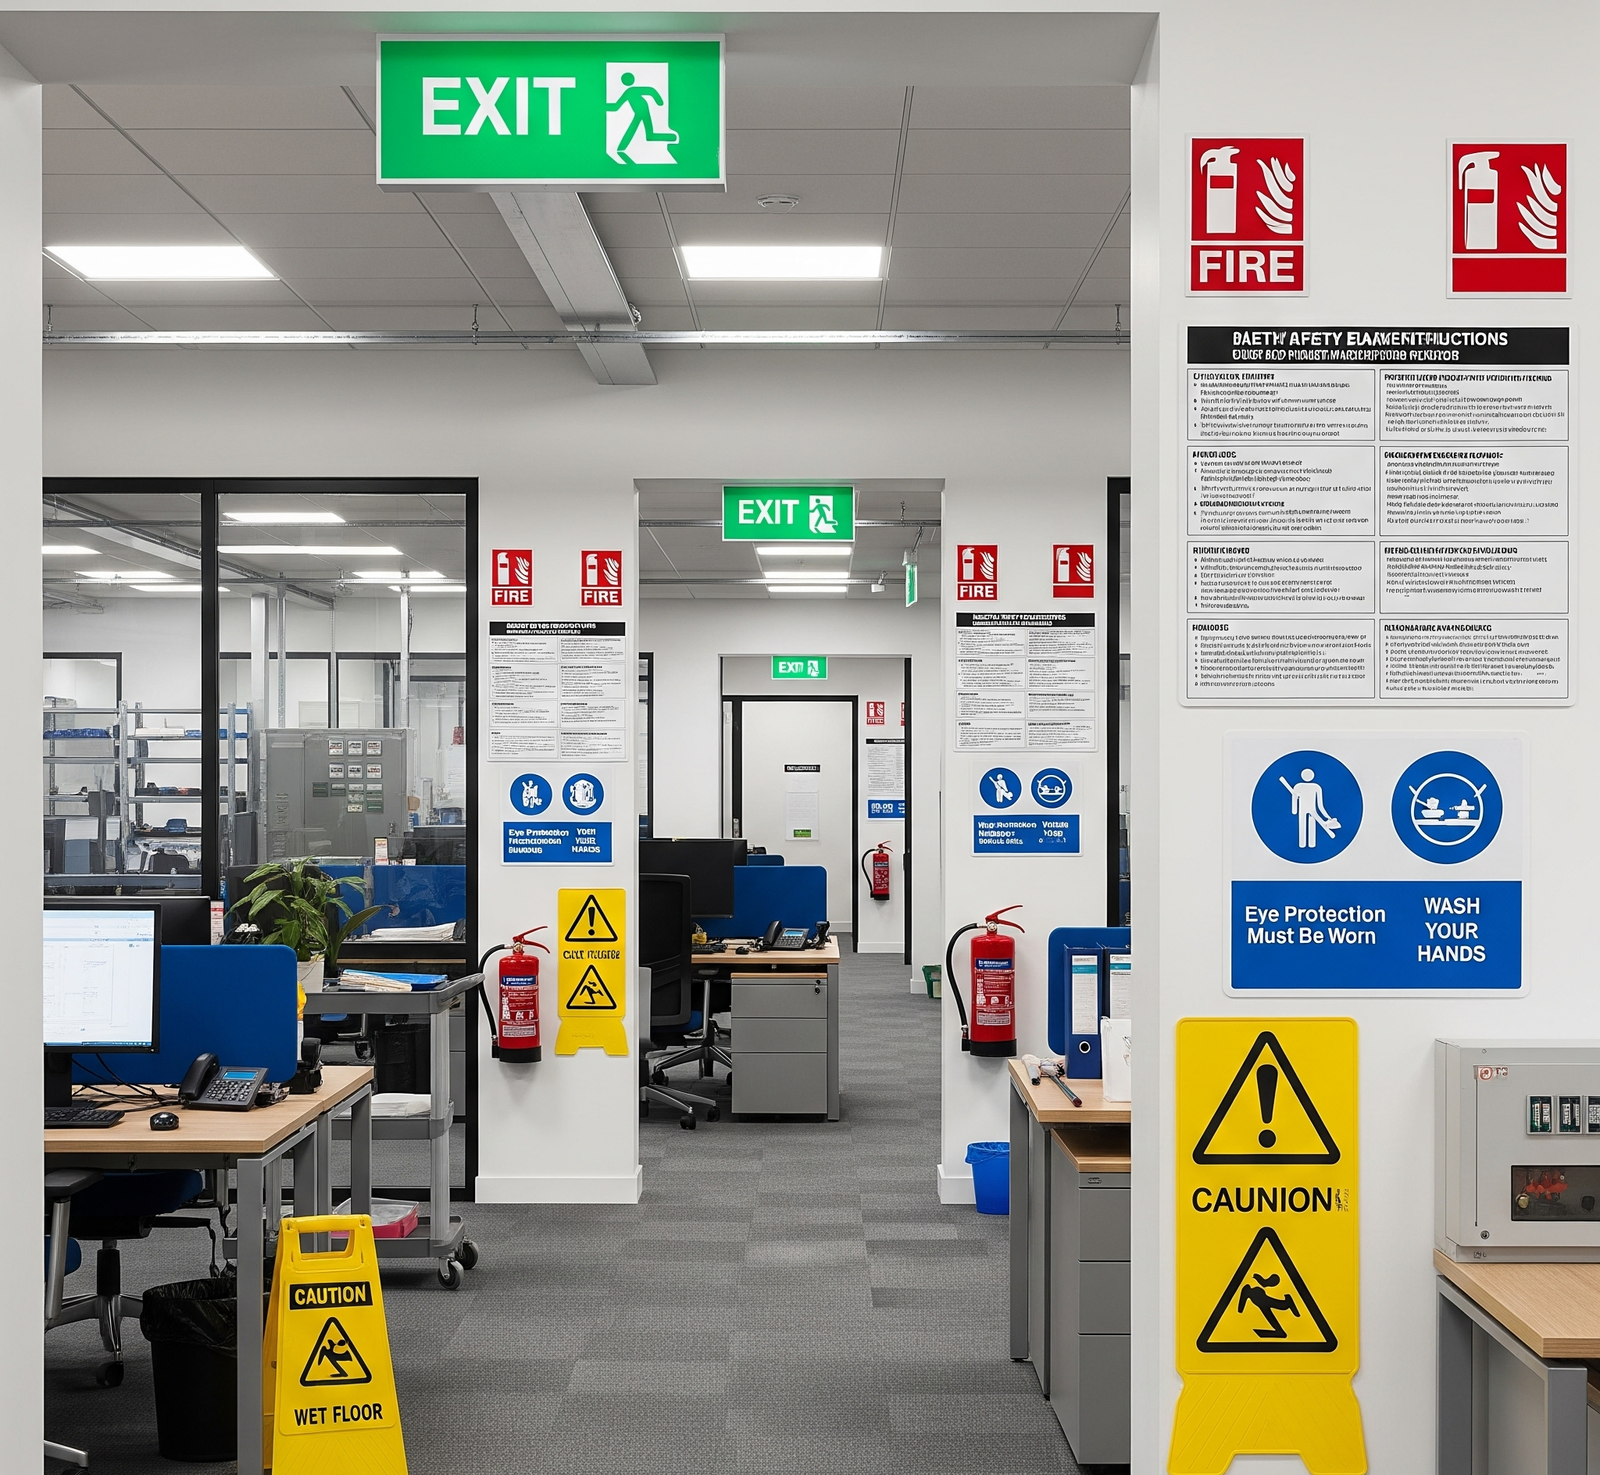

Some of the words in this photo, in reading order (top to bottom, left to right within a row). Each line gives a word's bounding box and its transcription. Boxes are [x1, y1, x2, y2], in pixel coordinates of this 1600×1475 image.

[422, 76, 576, 136] EXIT
[1198, 249, 1296, 284] FIRE
[738, 499, 800, 525] EXIT
[494, 589, 529, 604] FIRE
[583, 590, 619, 605] FIRE
[959, 585, 995, 599] FIRE
[1244, 905, 1280, 926] Eye
[1283, 905, 1387, 924] Protection
[1423, 896, 1481, 916] WASH
[1247, 927, 1295, 945] Must
[1299, 927, 1325, 945] Be
[1327, 927, 1377, 945] Worn
[1424, 921, 1480, 940] YOUR
[1416, 944, 1487, 963] HANDS
[1191, 1186, 1333, 1213] CAUNION
[294, 1285, 367, 1306] CAUTION
[294, 1406, 328, 1427] WET
[332, 1402, 384, 1424] FLOOR
